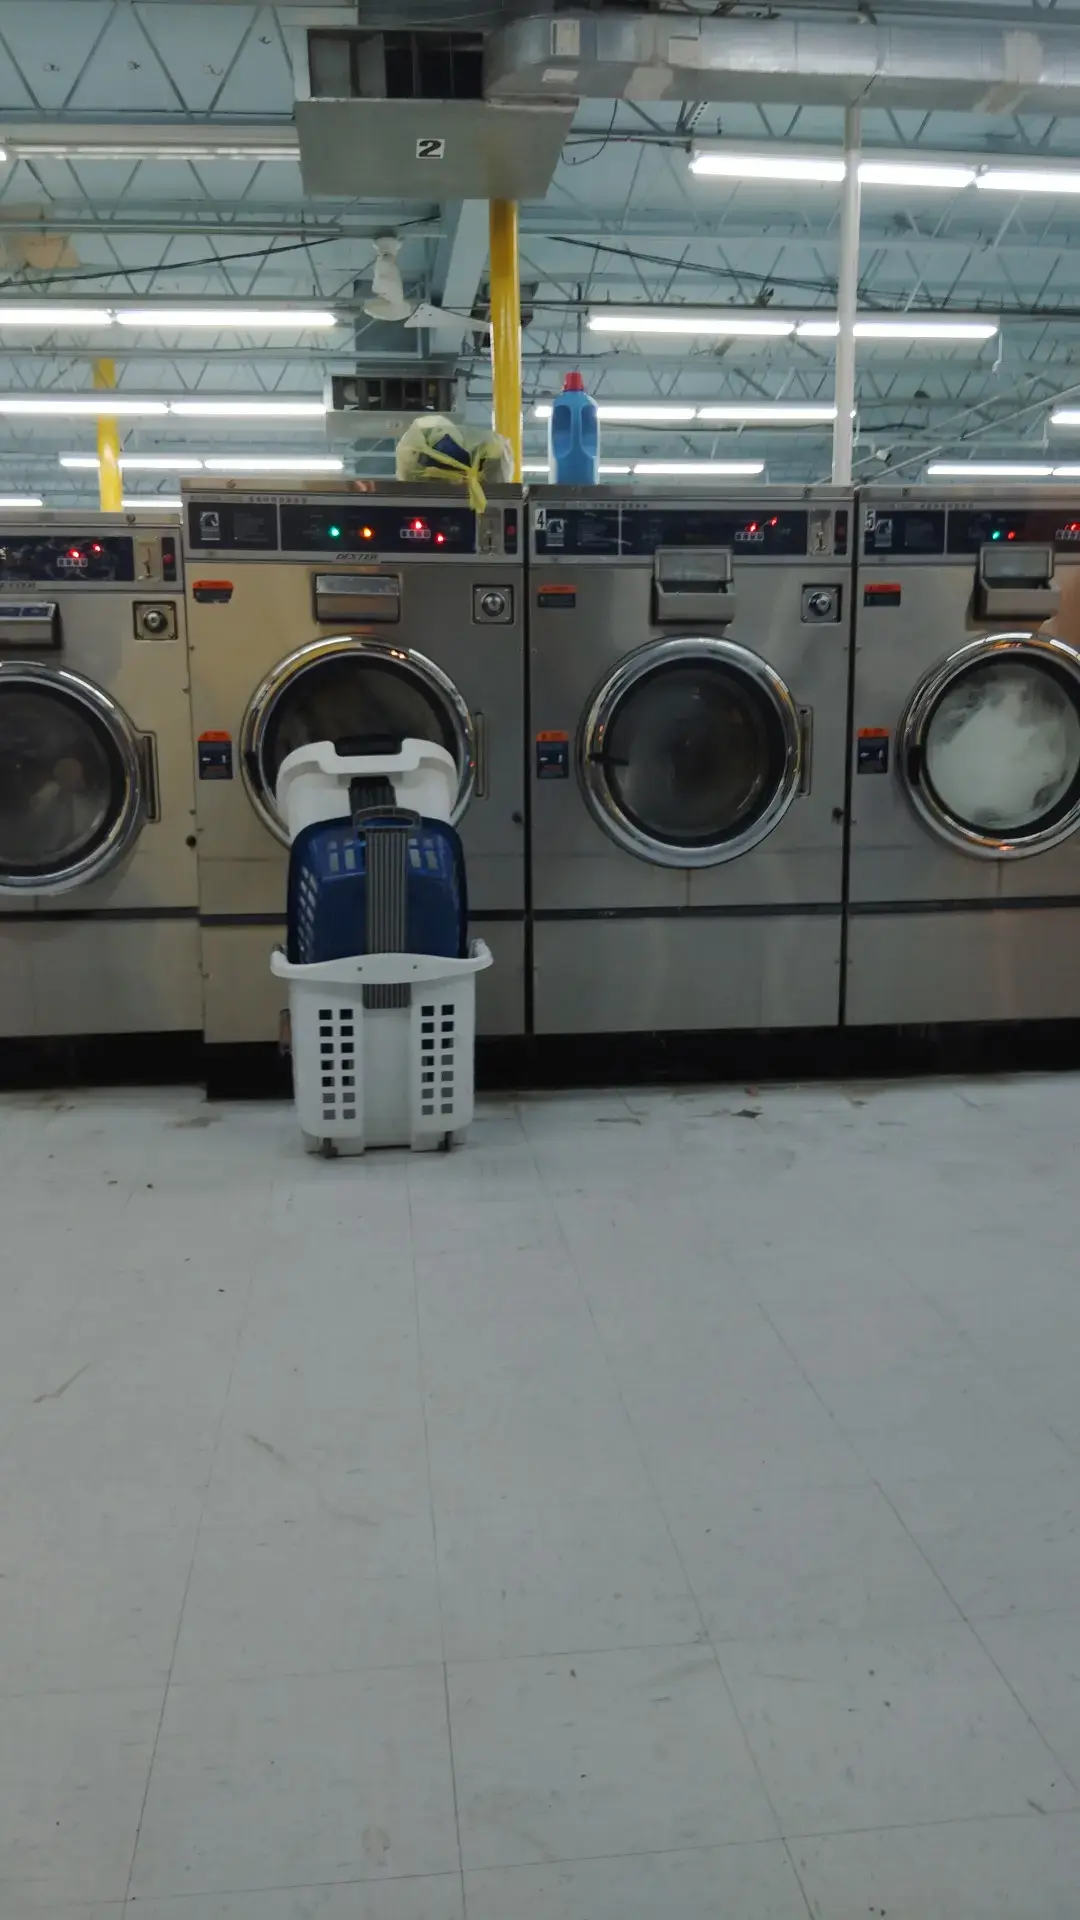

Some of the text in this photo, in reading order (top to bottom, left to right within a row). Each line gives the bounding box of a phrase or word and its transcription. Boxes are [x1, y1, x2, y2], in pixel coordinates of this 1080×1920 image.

[419, 139, 441, 157] 2
[537, 510, 545, 529] 4
[867, 511, 875, 529] 5
